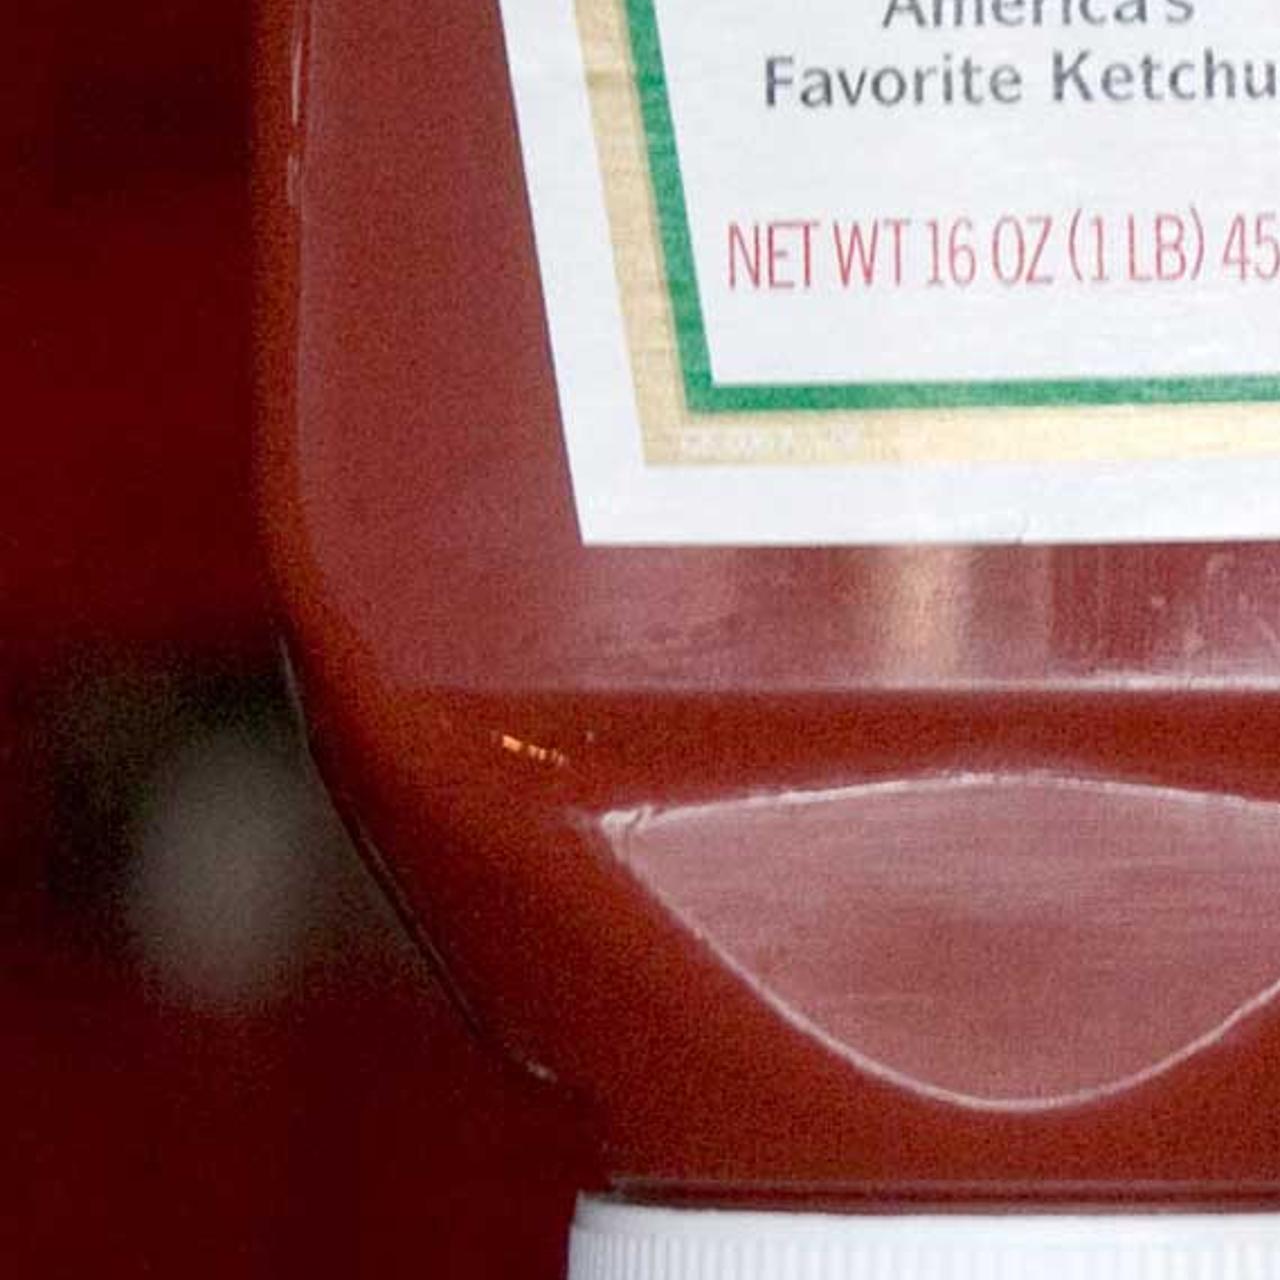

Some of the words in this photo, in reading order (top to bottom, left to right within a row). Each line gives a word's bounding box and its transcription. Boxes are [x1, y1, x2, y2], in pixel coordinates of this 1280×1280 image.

[764, 53, 1023, 109] Favorite
[727, 221, 820, 290] NET
[832, 219, 912, 289] WT
[926, 218, 978, 287] 16
[991, 215, 1054, 286] OZ
[1126, 205, 1205, 283] LB)
